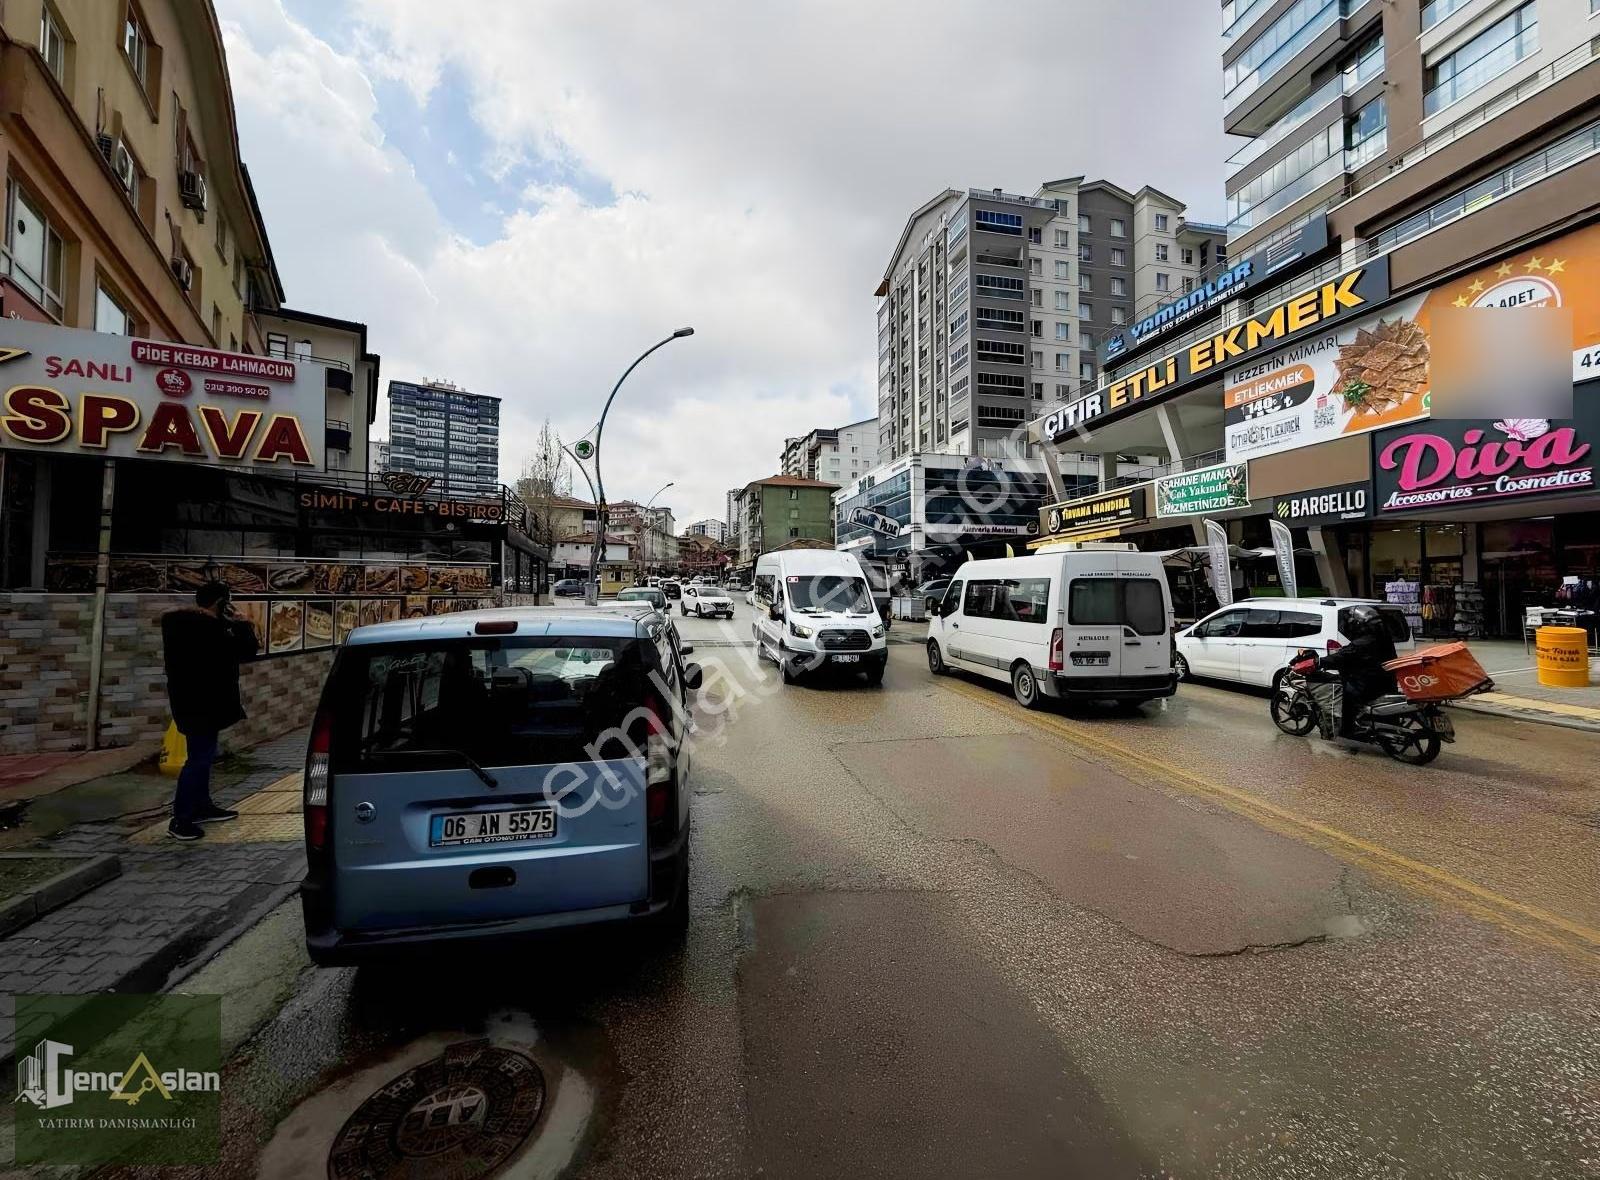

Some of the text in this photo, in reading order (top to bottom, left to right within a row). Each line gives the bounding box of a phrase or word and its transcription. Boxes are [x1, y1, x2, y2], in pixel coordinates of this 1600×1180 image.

[1131, 261, 1253, 338] YAMANLAR
[46, 356, 132, 383] ŞANLI
[137, 344, 294, 378] PİDE KEBAP LAHMACUN
[1045, 269, 1366, 441] ÇITIR ETLİ EKMEK
[1233, 356, 1284, 384] LEZZETİN
[1234, 369, 1304, 403] ETLİEKMEK
[1380, 427, 1591, 491] Diva
[1200, 466, 1239, 484] MANAV
[1384, 486, 1473, 507] Accessories
[1495, 469, 1592, 493] Cosmetics
[300, 490, 358, 511] SİMİT
[374, 498, 425, 514] CAFE
[1291, 489, 1366, 518] BARGELLO
[444, 810, 553, 838] 06 AN 5575
